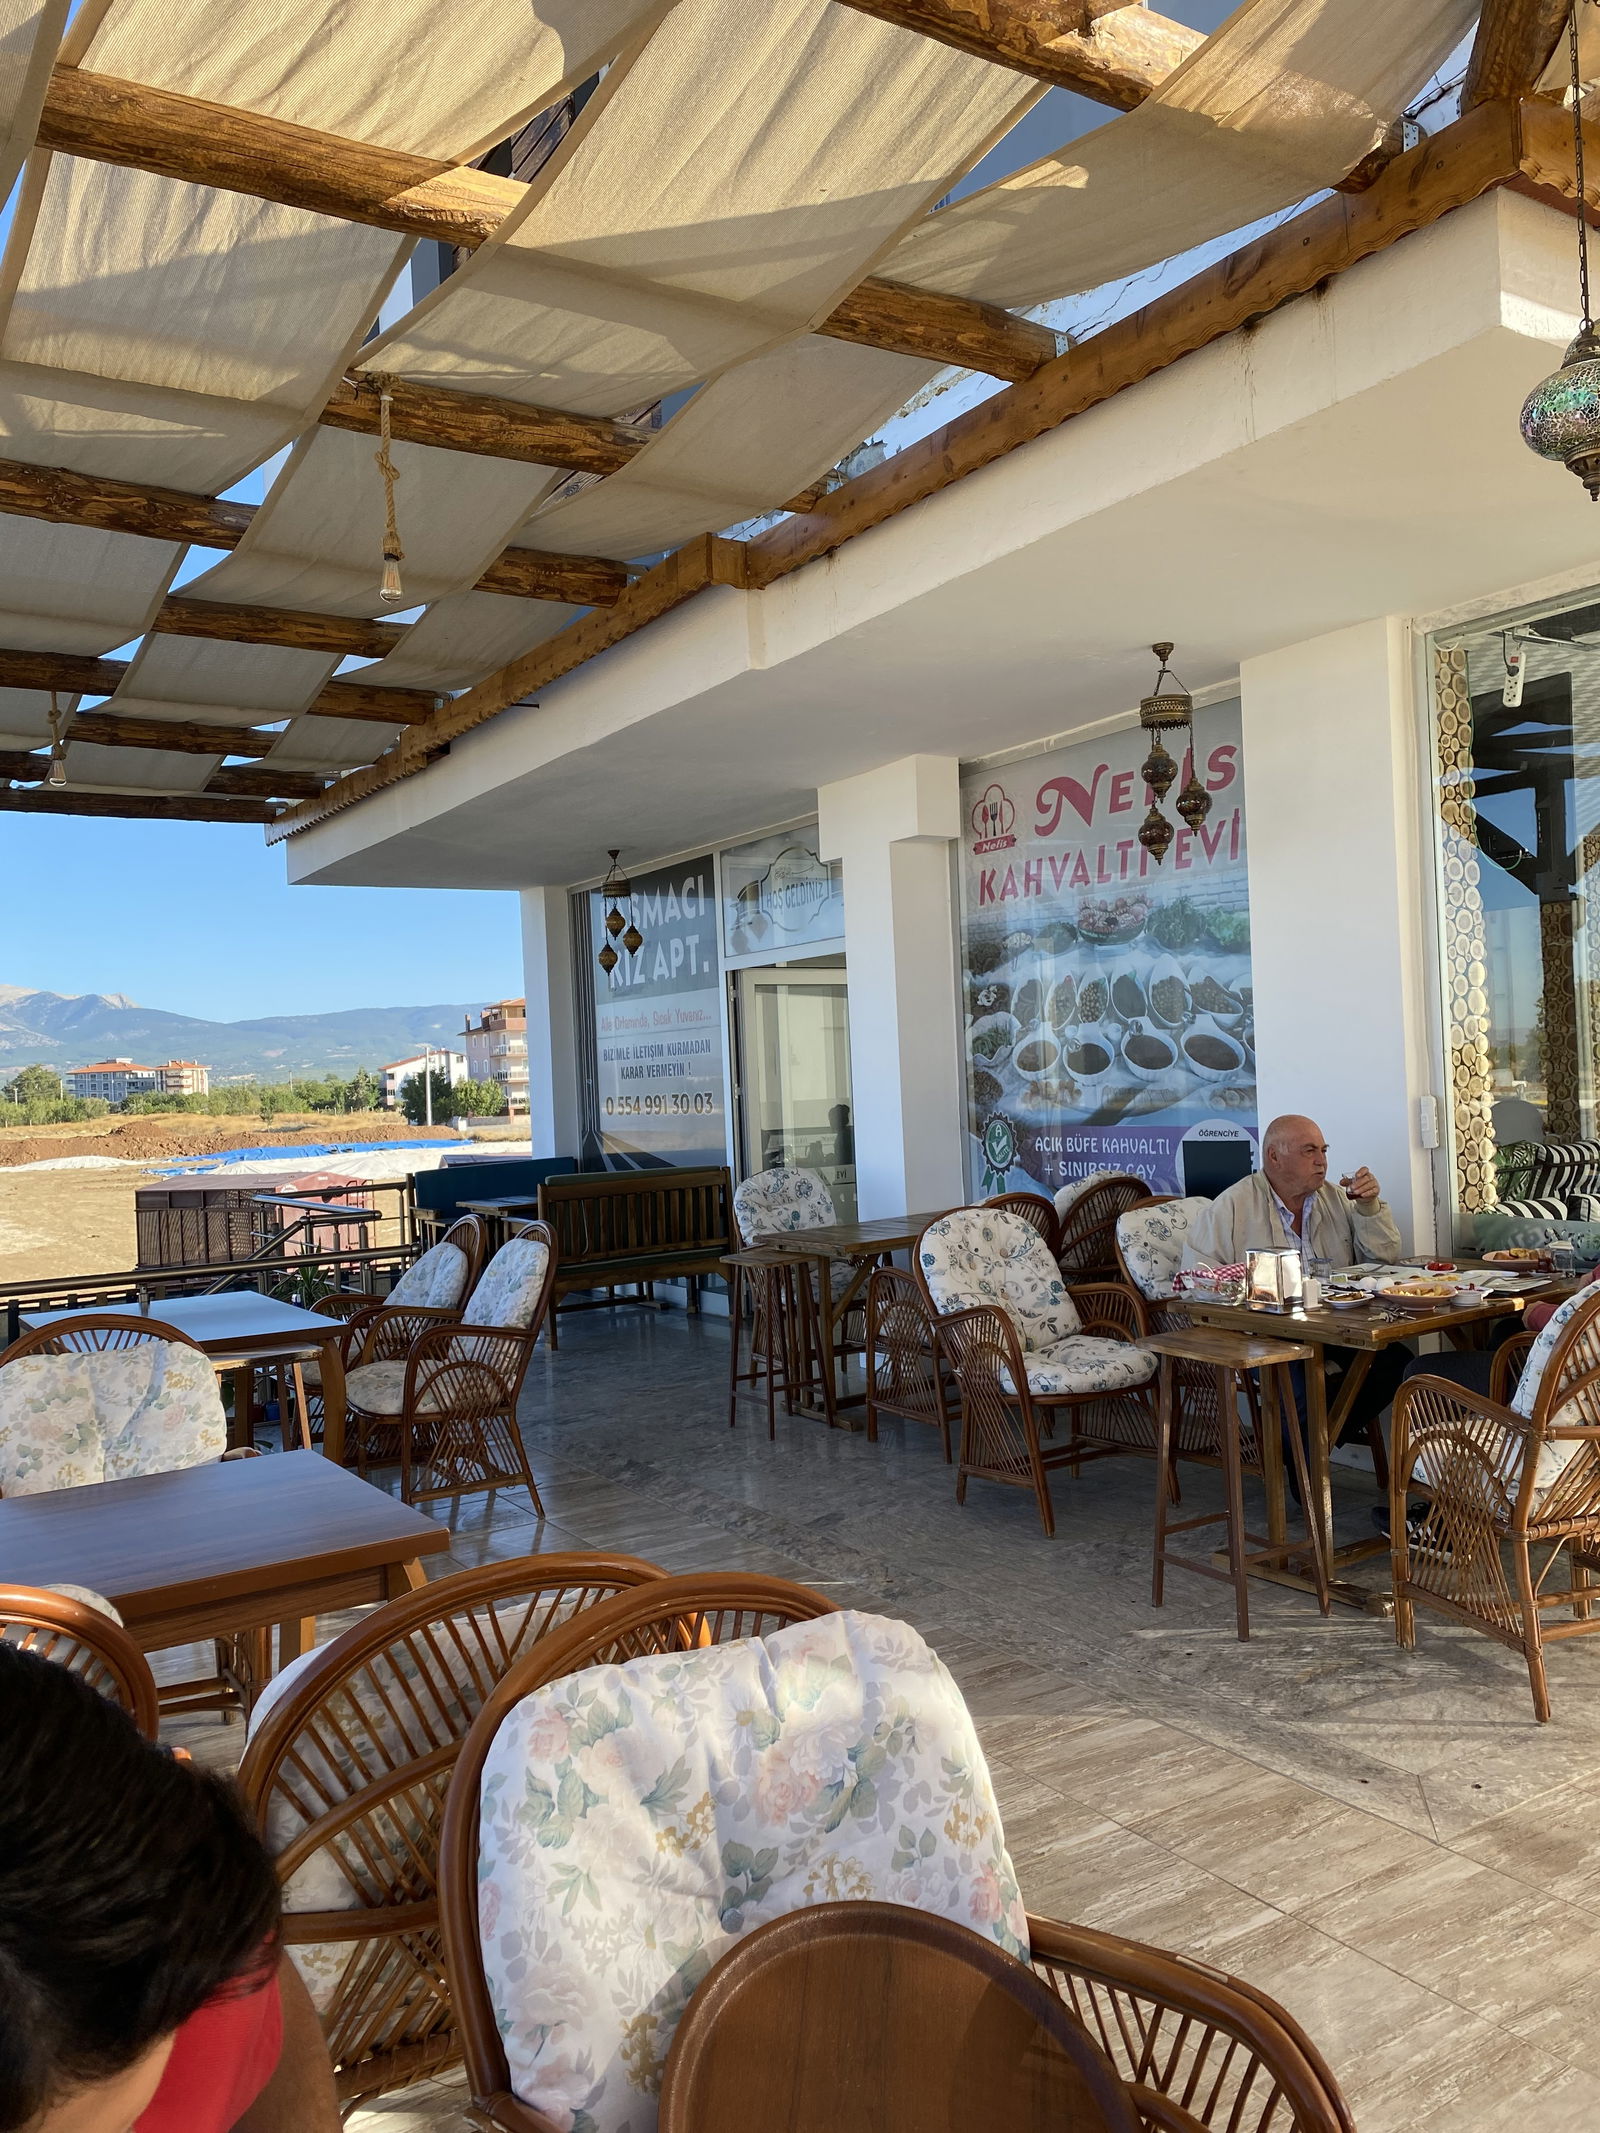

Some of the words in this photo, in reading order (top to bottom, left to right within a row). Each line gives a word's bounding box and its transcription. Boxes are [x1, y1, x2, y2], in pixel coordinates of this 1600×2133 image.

[979, 839, 1148, 906] KAHVALTI
[600, 874, 705, 938] SMACI
[785, 876, 824, 909] GELDİNİZ
[652, 934, 710, 981] APT.
[667, 1038, 711, 1057] KURMADAN
[620, 1065, 644, 1080] KARAR
[646, 1060, 685, 1079] VERMEYİN
[605, 1096, 615, 1116] 0
[617, 1095, 642, 1116] 554
[644, 1094, 668, 1116] 991
[671, 1093, 690, 1115] 30
[693, 1092, 714, 1115] 03
[1035, 1136, 1063, 1155] AÇIK
[1066, 1133, 1098, 1154] BÜFE
[1102, 1137, 1170, 1155] KAHVALTI
